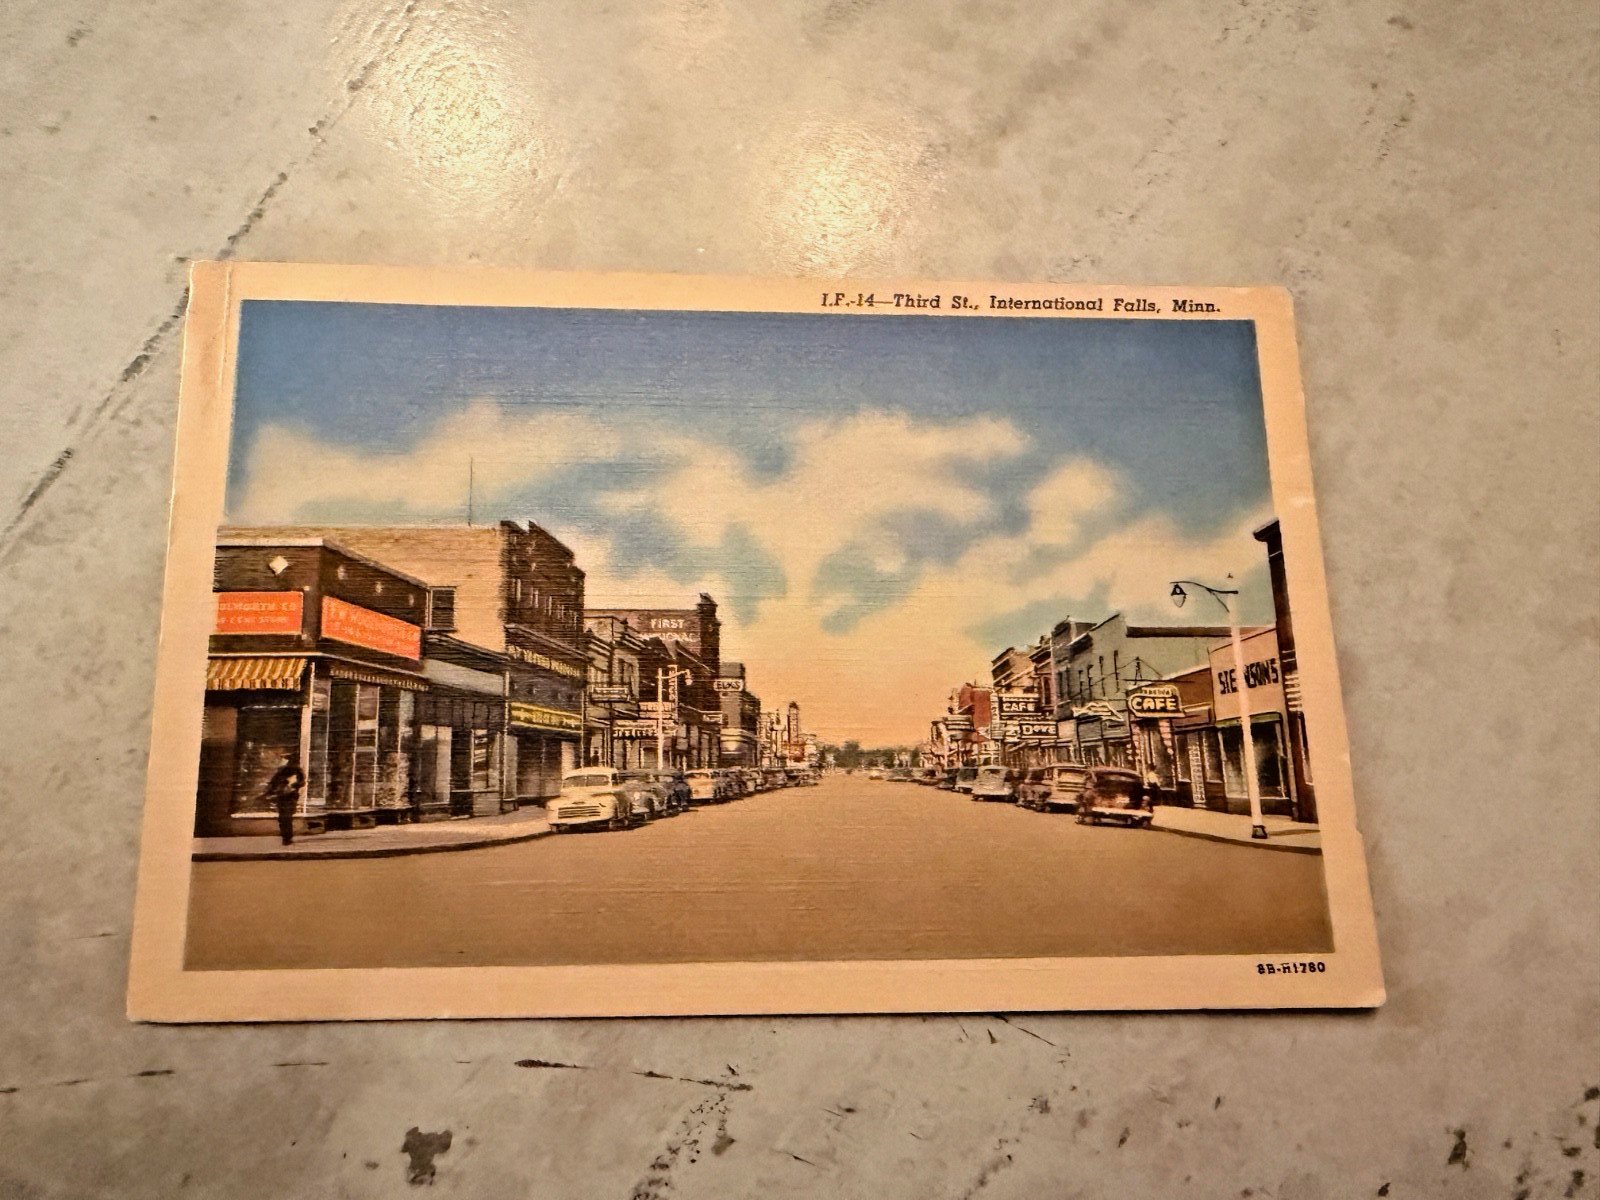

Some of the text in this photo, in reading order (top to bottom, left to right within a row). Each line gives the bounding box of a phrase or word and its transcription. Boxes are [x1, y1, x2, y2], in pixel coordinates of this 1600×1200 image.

[989, 295, 1103, 311] International
[1113, 298, 1161, 314] Falls,
[1172, 299, 1221, 313] Minn.
[649, 618, 685, 629] FIRST
[1002, 702, 1035, 712] CAFE
[1132, 697, 1177, 711] CAFE
